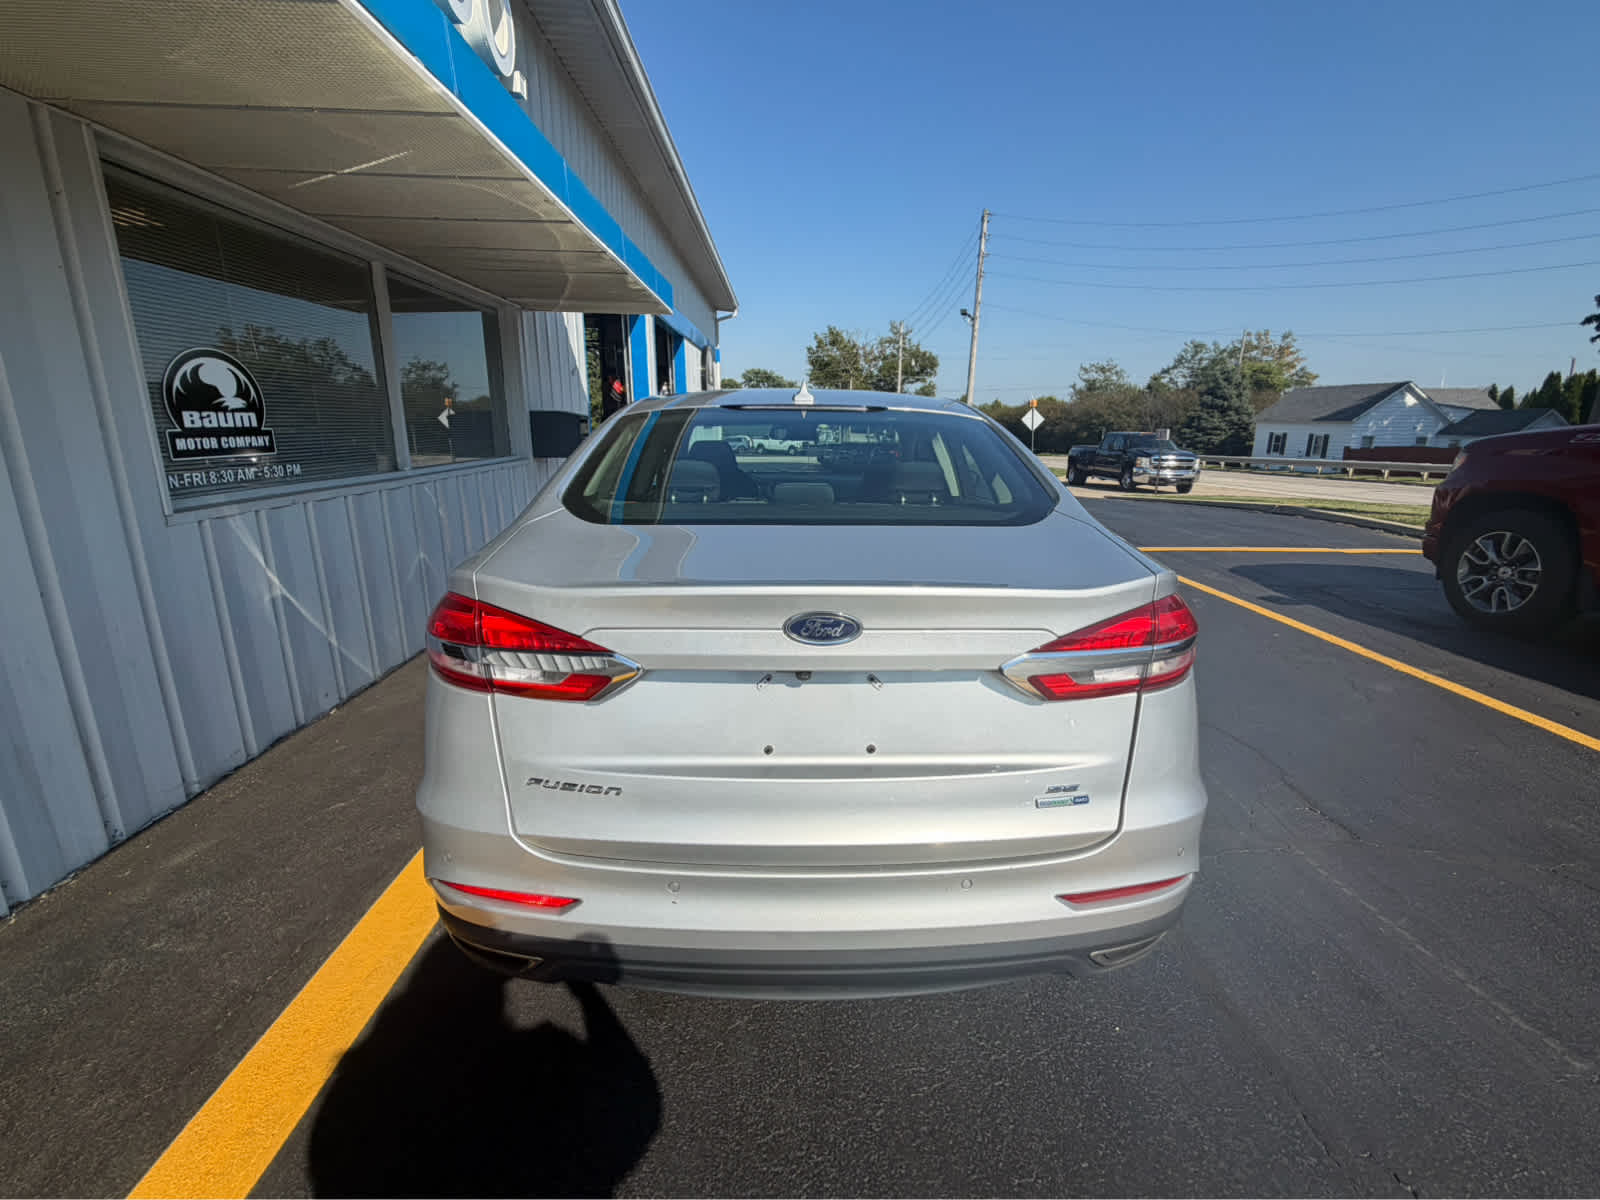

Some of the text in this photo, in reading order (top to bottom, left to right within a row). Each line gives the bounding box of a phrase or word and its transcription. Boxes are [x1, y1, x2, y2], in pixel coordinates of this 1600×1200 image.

[175, 435, 270, 451] MOTOR COMPANY
[208, 470, 235, 484] 8:30
[237, 467, 256, 481] AM
[263, 464, 284, 478] 5:30
[286, 463, 302, 476] PM
[800, 618, 845, 638] Ford
